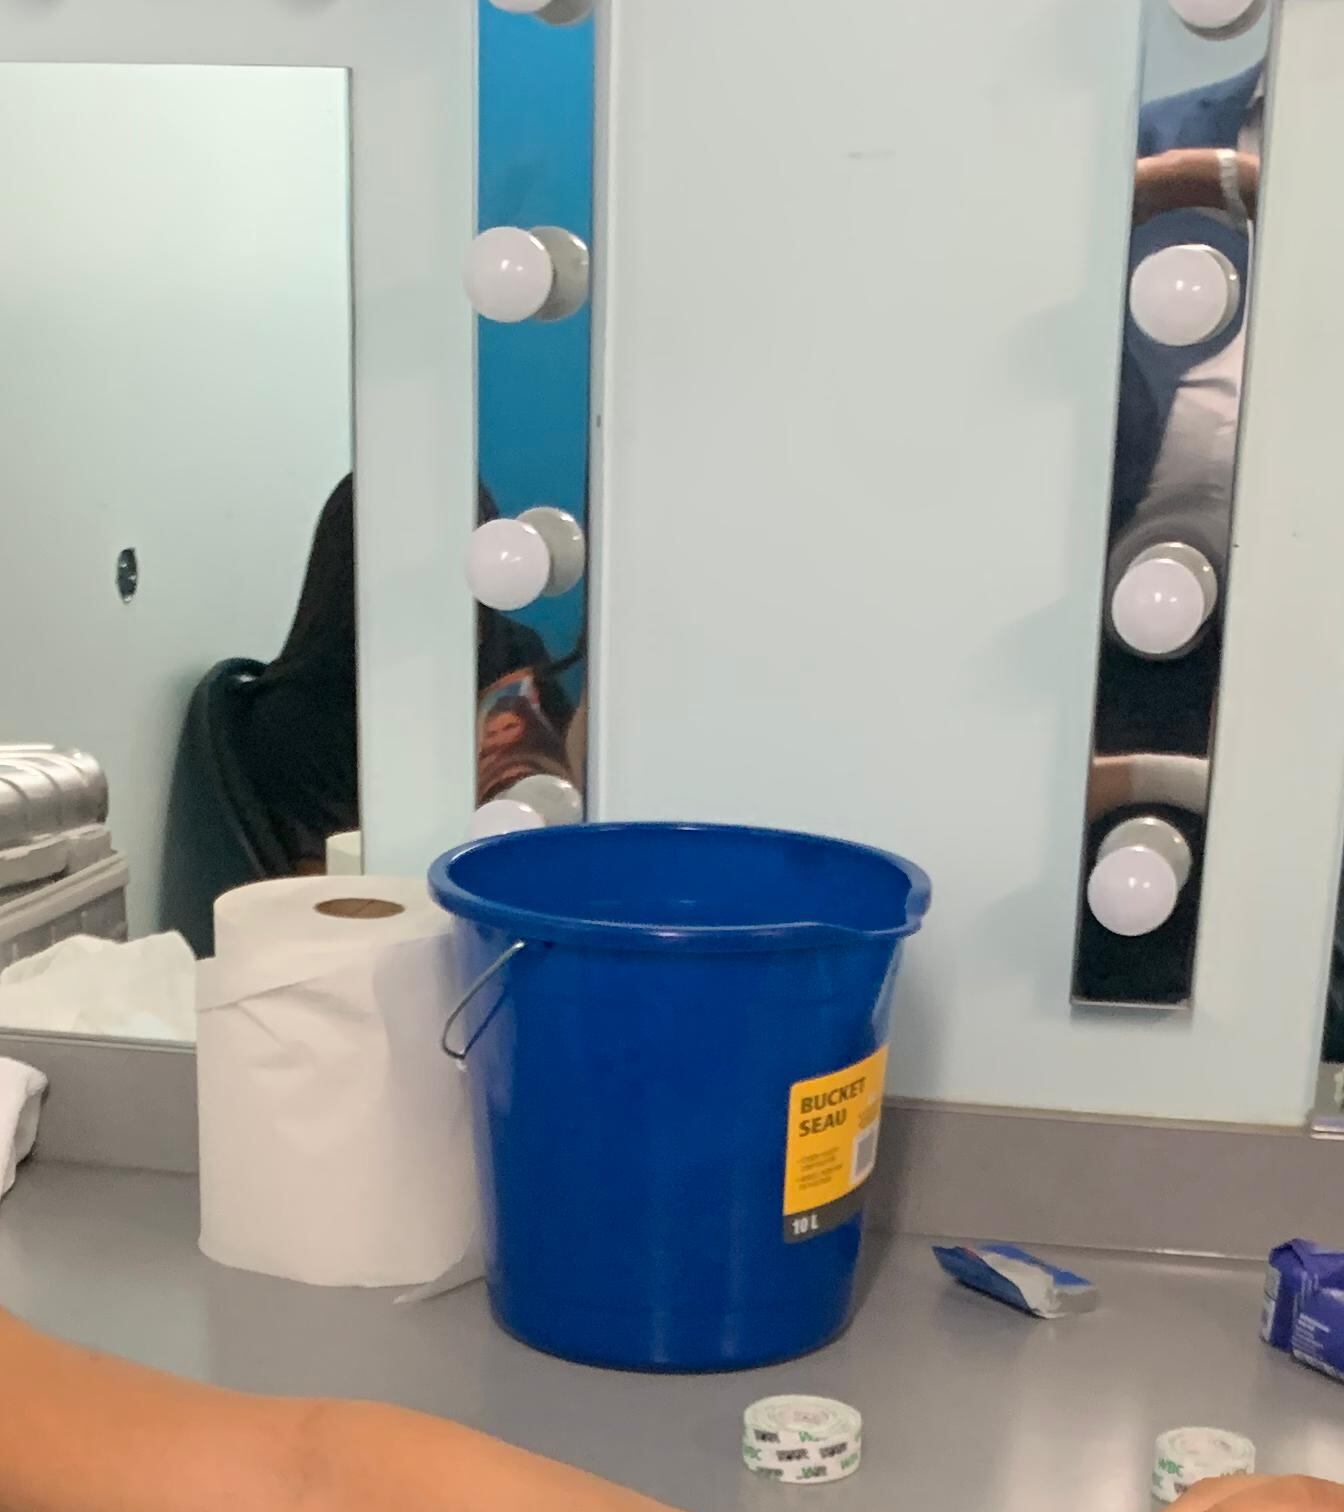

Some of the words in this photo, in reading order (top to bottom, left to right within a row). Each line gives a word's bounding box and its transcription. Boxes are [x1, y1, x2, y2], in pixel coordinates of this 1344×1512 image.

[800, 1076, 866, 1115] BUCKET
[799, 1108, 848, 1137] SEAU
[792, 1218, 808, 1235] 10
[811, 1213, 819, 1229] L
